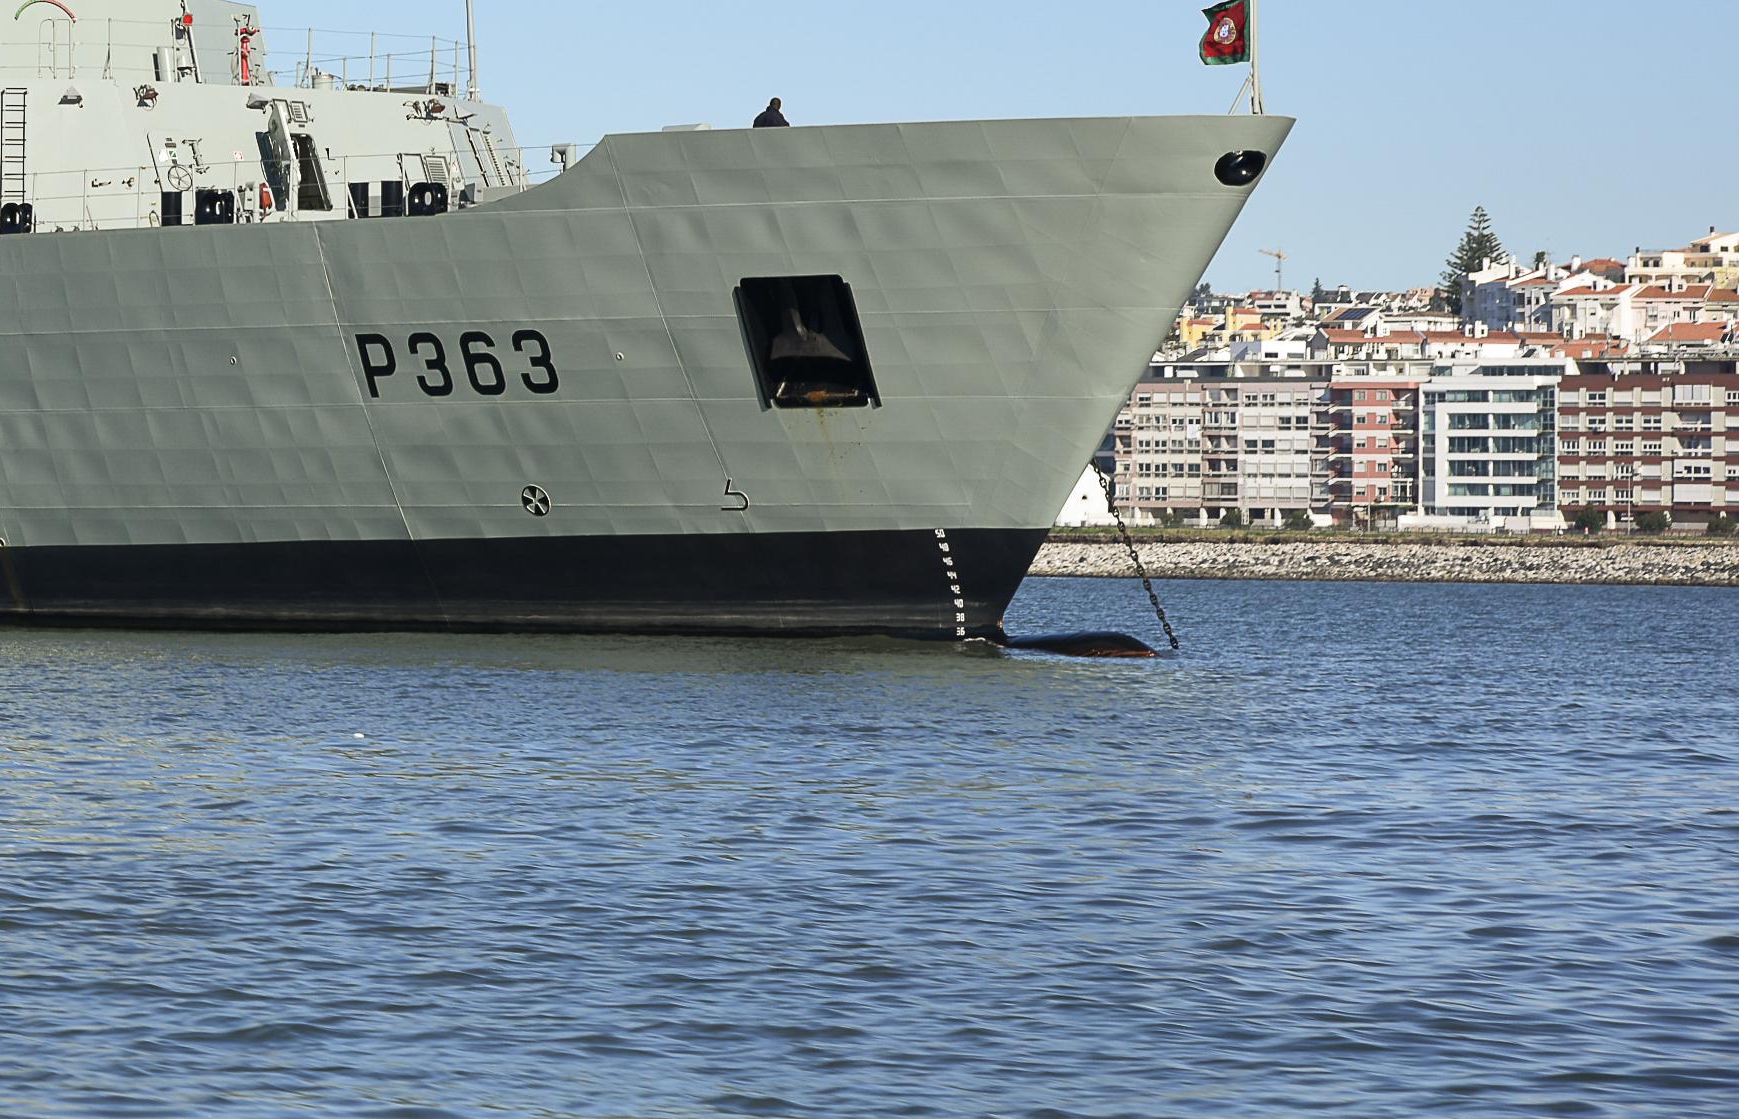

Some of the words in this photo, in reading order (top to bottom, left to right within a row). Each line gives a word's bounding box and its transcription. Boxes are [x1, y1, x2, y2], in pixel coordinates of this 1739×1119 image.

[355, 330, 559, 398] P363
[935, 528, 946, 538] 50
[943, 557, 953, 566] 46
[947, 571, 958, 580] 44
[951, 585, 961, 594] 42
[954, 599, 964, 608] 40
[956, 613, 965, 622] 38
[956, 627, 966, 636] 36
